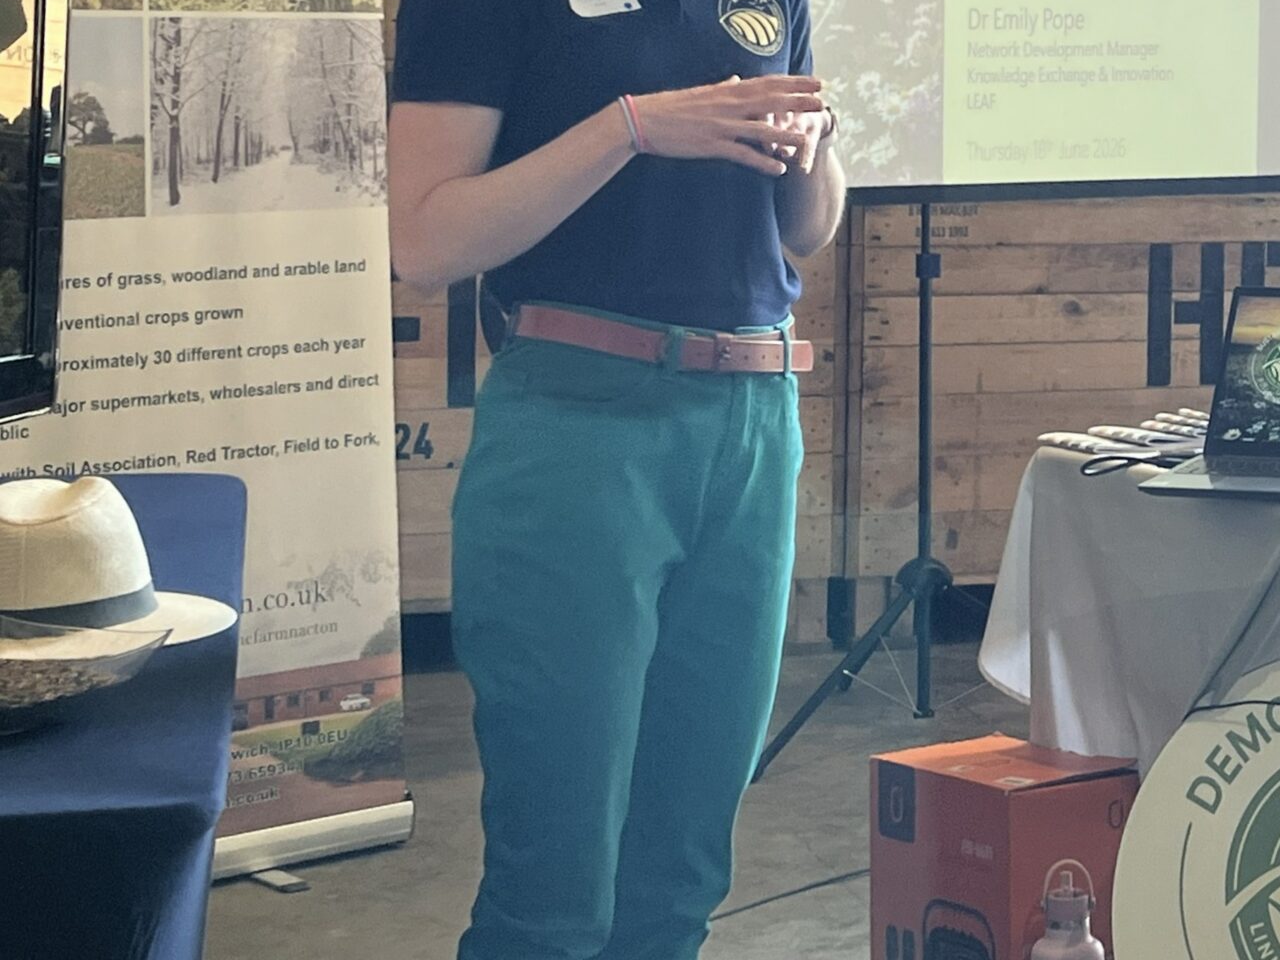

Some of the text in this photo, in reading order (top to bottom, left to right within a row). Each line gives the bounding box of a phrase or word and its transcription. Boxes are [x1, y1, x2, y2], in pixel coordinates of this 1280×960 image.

[968, 7, 1085, 38] Dr Emily Pope
[967, 41, 1160, 61] Network Development Manager
[967, 65, 1175, 87] Knowledge Exchange & Innovation
[966, 93, 997, 110] LEAF
[966, 140, 1029, 164] Thursday
[96, 272, 113, 288] of
[117, 271, 166, 289] grass,
[171, 266, 248, 282] woodland
[252, 263, 280, 279] and
[284, 259, 330, 275] arable
[335, 259, 366, 273] land
[145, 311, 189, 326] crops
[194, 307, 244, 325] grown
[153, 349, 172, 364] 30
[176, 345, 243, 363] different
[246, 340, 289, 359] crops
[293, 338, 329, 353] each
[333, 336, 366, 354] year
[52, 373, 380, 417] ajor supermarkets, wholesalers and direct
[394, 422, 434, 460] 24
[43, 462, 76, 477] Soil
[80, 455, 182, 476] Association,
[186, 448, 217, 464] Red
[221, 442, 280, 460] Tractor,
[284, 438, 320, 454] Field
[325, 438, 339, 449] to
